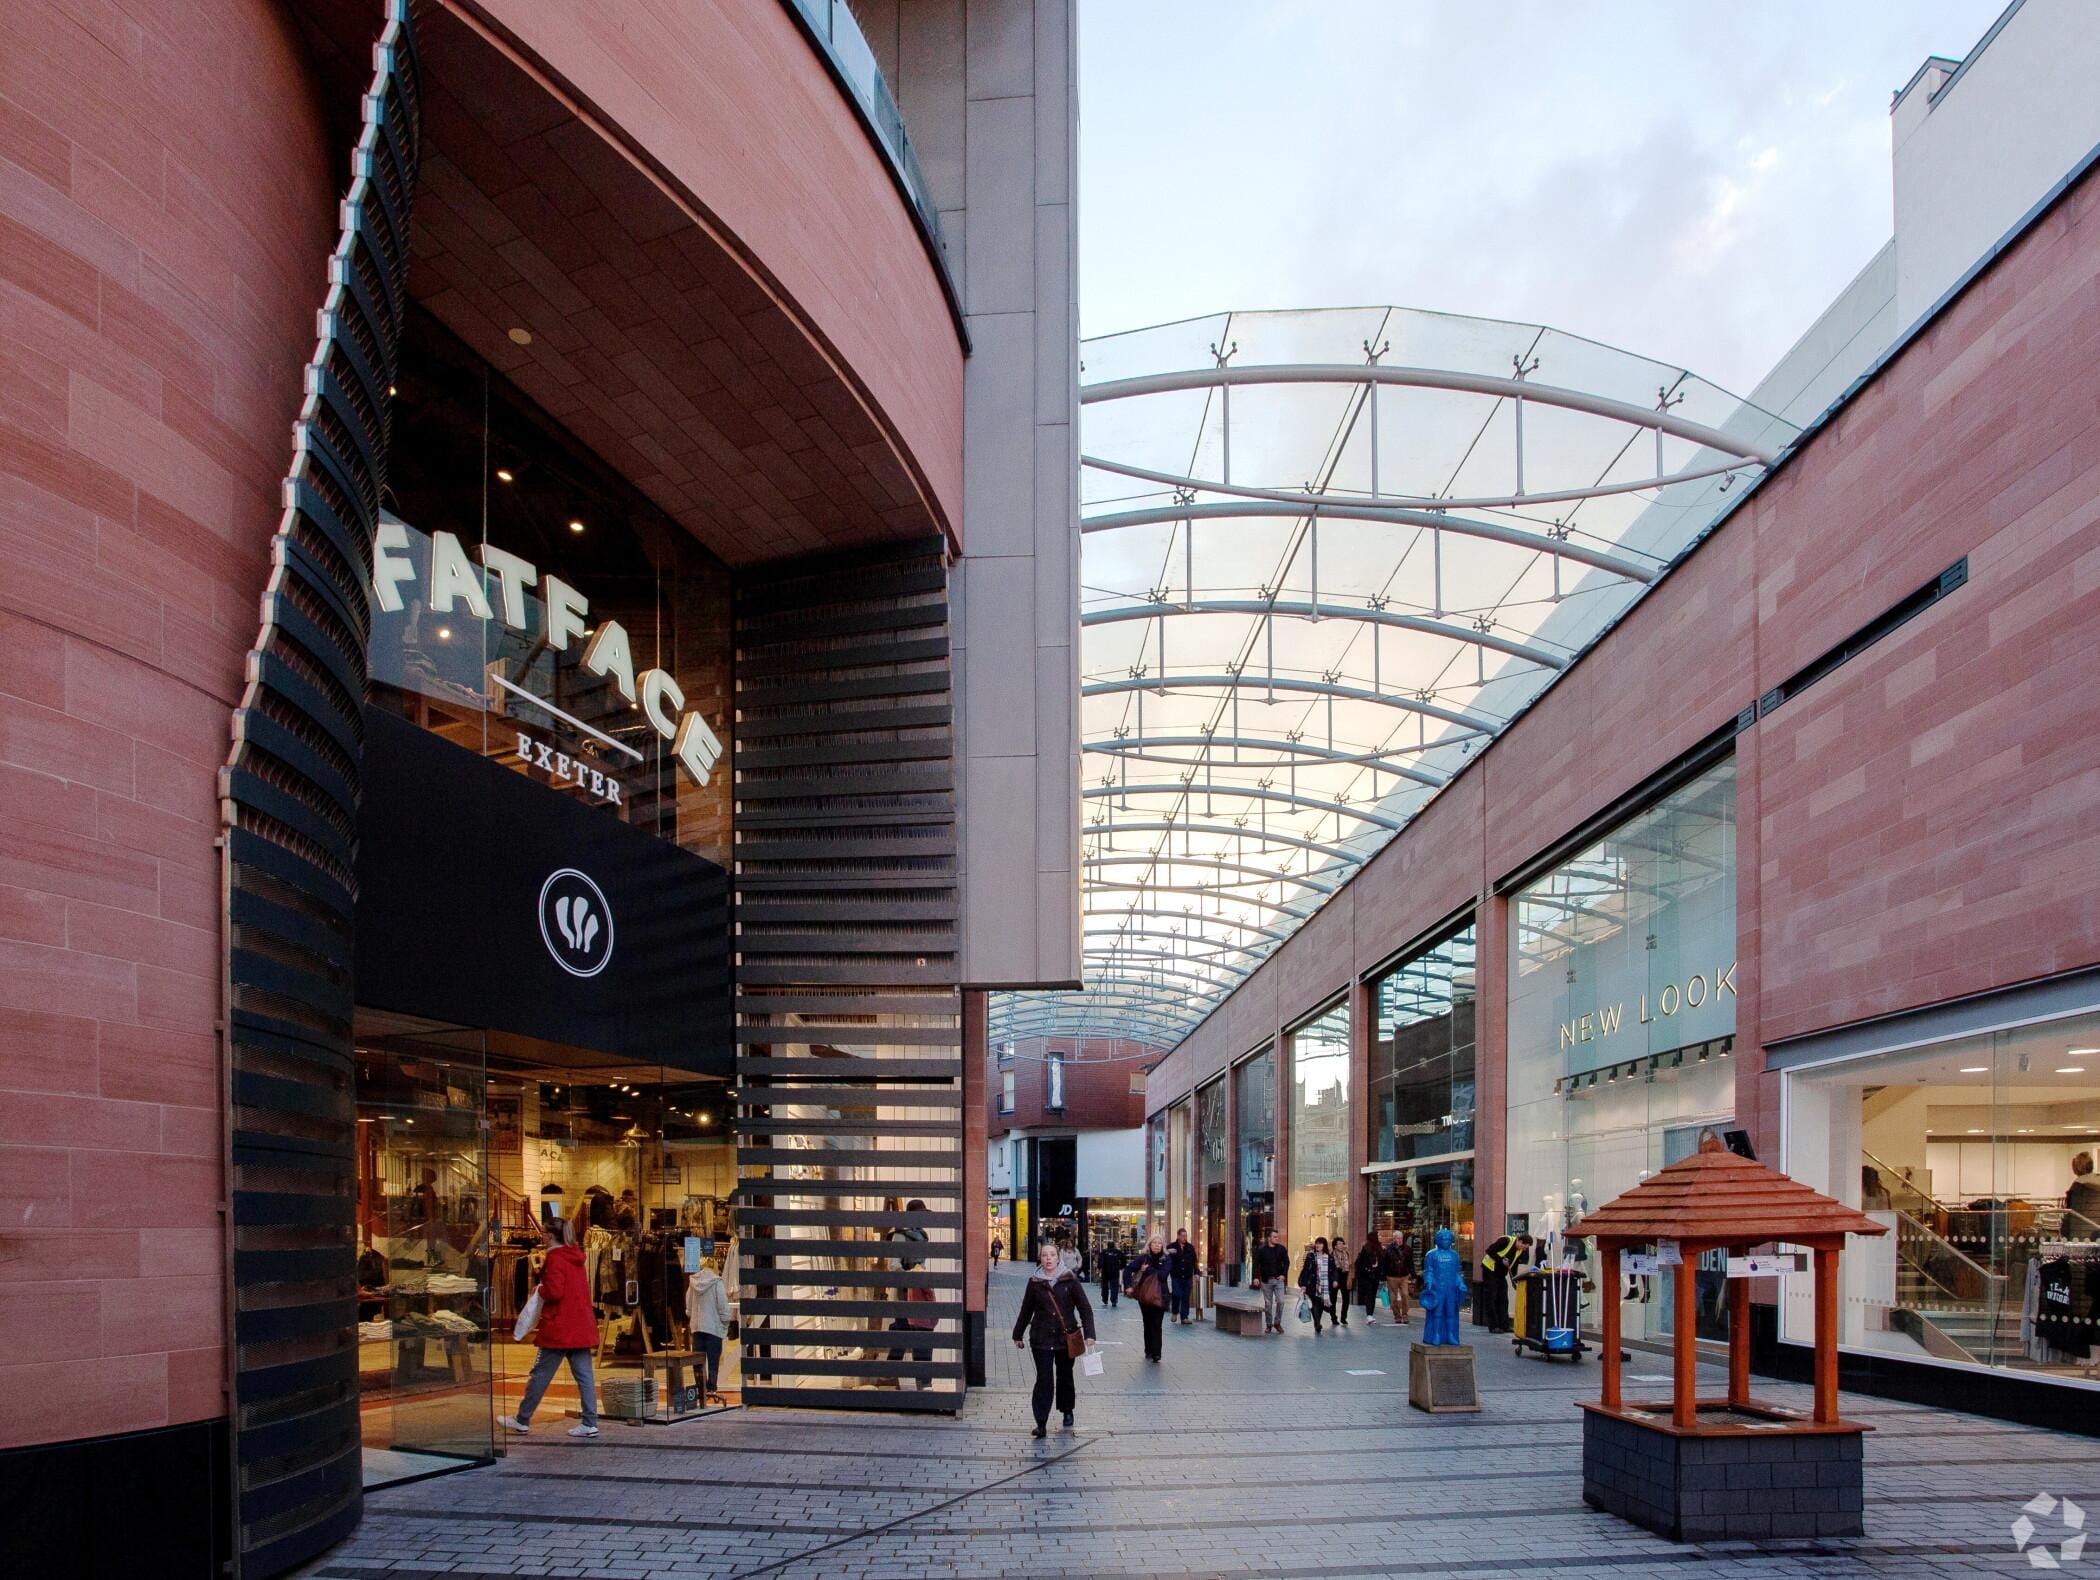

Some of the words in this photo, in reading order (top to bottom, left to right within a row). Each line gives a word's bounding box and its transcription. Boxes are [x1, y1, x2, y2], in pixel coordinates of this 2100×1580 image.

[371, 523, 724, 787] FATFACE
[516, 732, 622, 805] EXETER
[1560, 1003, 1623, 1049] NEW
[1641, 962, 1737, 1024] LOOK
[1058, 1204, 1073, 1215] JD
